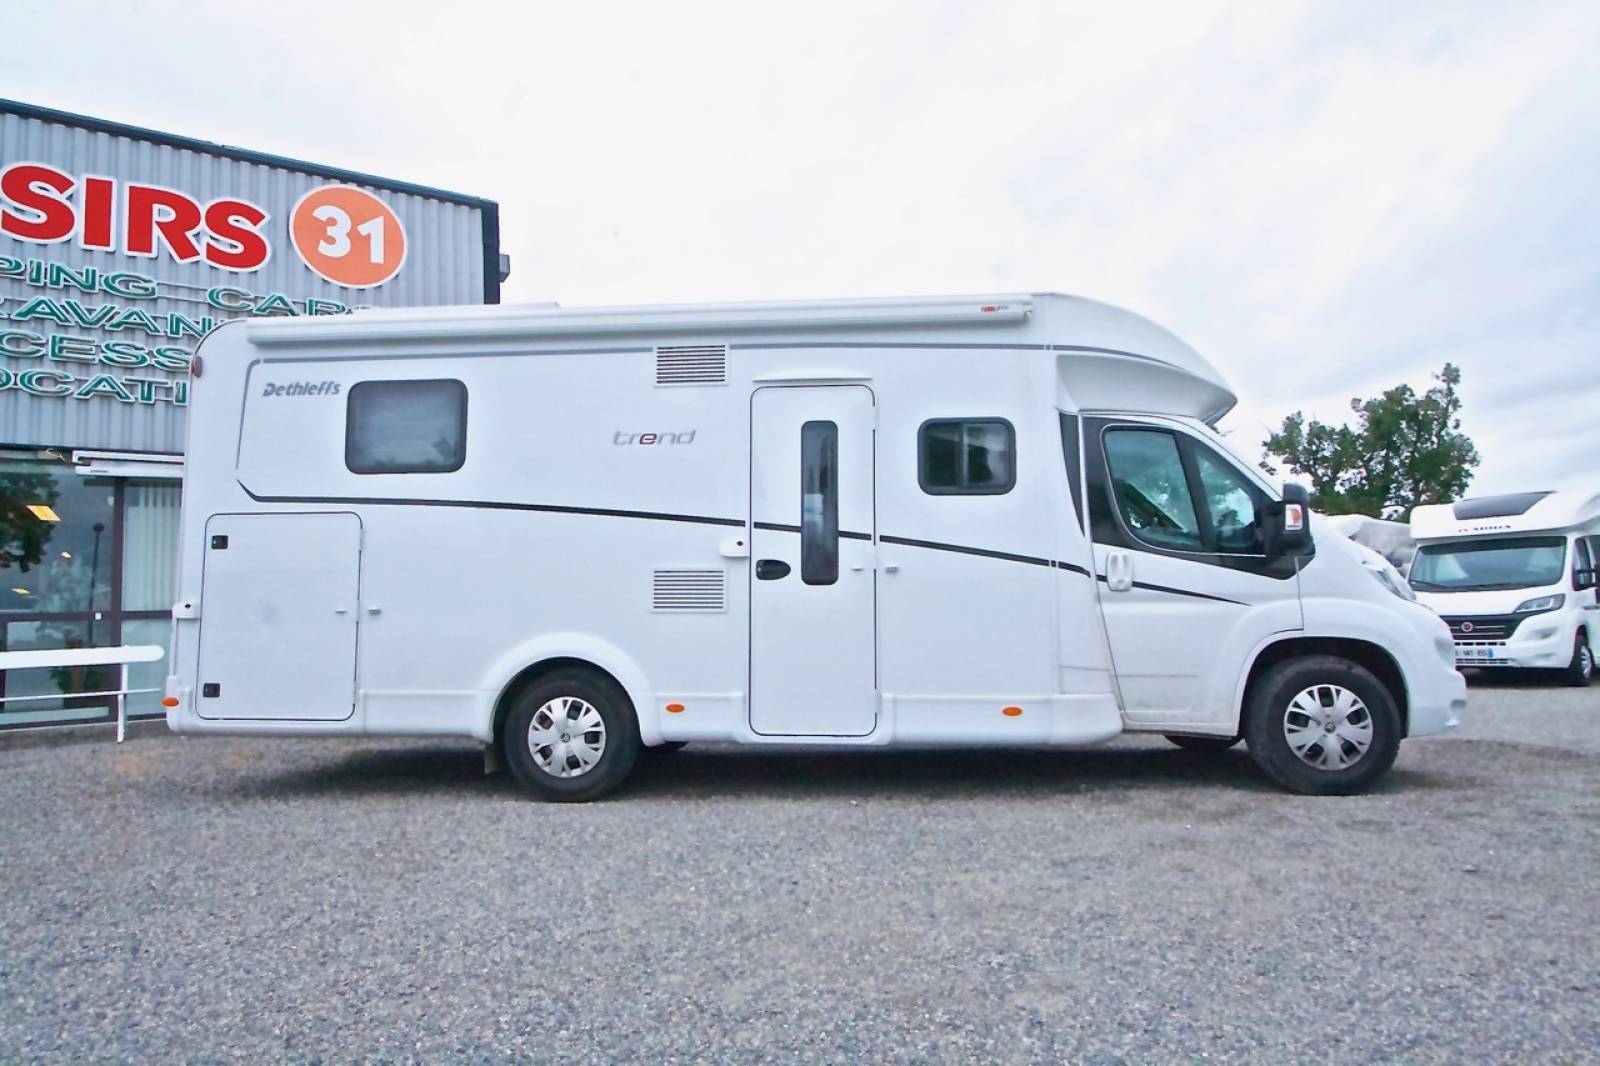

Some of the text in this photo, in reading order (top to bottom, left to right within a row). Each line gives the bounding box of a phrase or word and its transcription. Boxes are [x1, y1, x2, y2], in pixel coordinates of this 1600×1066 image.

[0, 163, 385, 271] SIRS 31
[0, 296, 226, 339] AVAN
[262, 380, 341, 397] Dethleffs
[612, 429, 697, 446] trend
